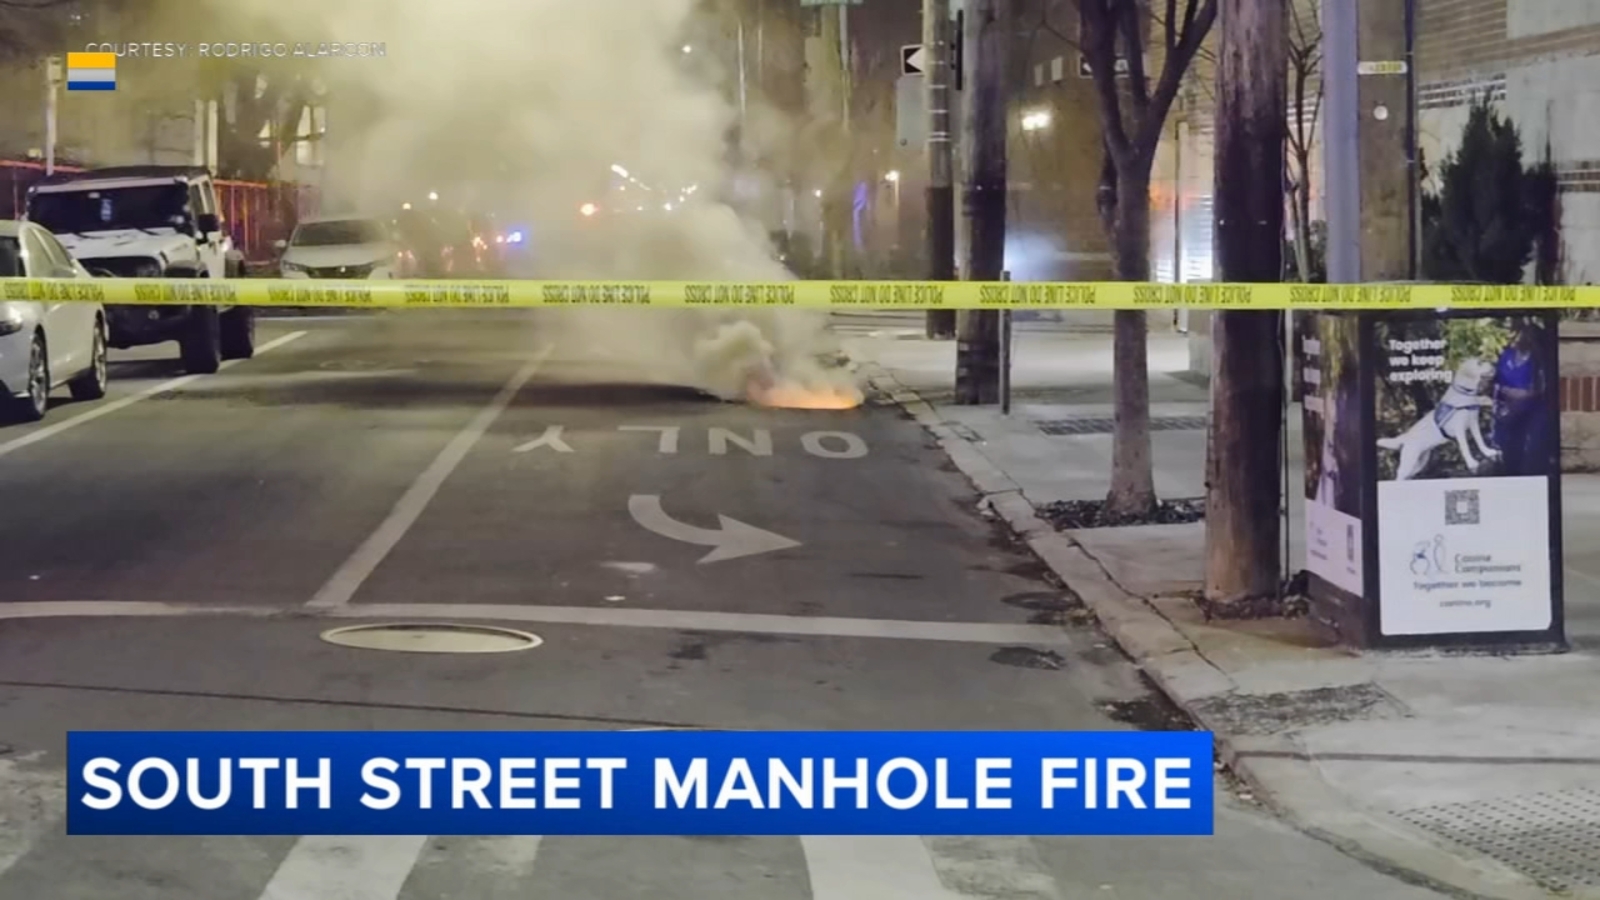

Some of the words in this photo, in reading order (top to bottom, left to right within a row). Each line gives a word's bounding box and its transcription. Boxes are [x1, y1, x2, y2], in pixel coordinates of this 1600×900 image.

[685, 284, 711, 303] CROSS
[714, 284, 730, 303] NOT
[731, 284, 744, 303] DO
[745, 284, 764, 303] LINE
[766, 284, 795, 303] POLICE
[830, 285, 858, 303] CROSS
[860, 285, 876, 303] NOT
[878, 285, 891, 303] DO
[892, 285, 912, 303] LINE
[914, 285, 944, 303] POLICE
[980, 285, 1009, 303] CROSS
[1010, 285, 1028, 303] NOT
[1029, 285, 1042, 303] DO
[1044, 285, 1065, 303] LINE
[1066, 285, 1096, 303] POLICE
[1133, 285, 1162, 303] CROSS
[1164, 285, 1182, 303] NOT
[1184, 285, 1197, 303] DO
[1198, 285, 1220, 303] LINE
[1221, 285, 1252, 303] POLICE
[1290, 285, 1320, 303] CROSS
[1321, 285, 1339, 303] NOT
[1341, 285, 1356, 303] DO
[1357, 285, 1378, 303] LINE
[1379, 285, 1411, 303] POLICE
[1389, 339, 1447, 354] Together
[1389, 357, 1410, 367] we
[1411, 354, 1446, 369] keep
[1389, 369, 1453, 385] exploring
[511, 425, 869, 459] ONLY
